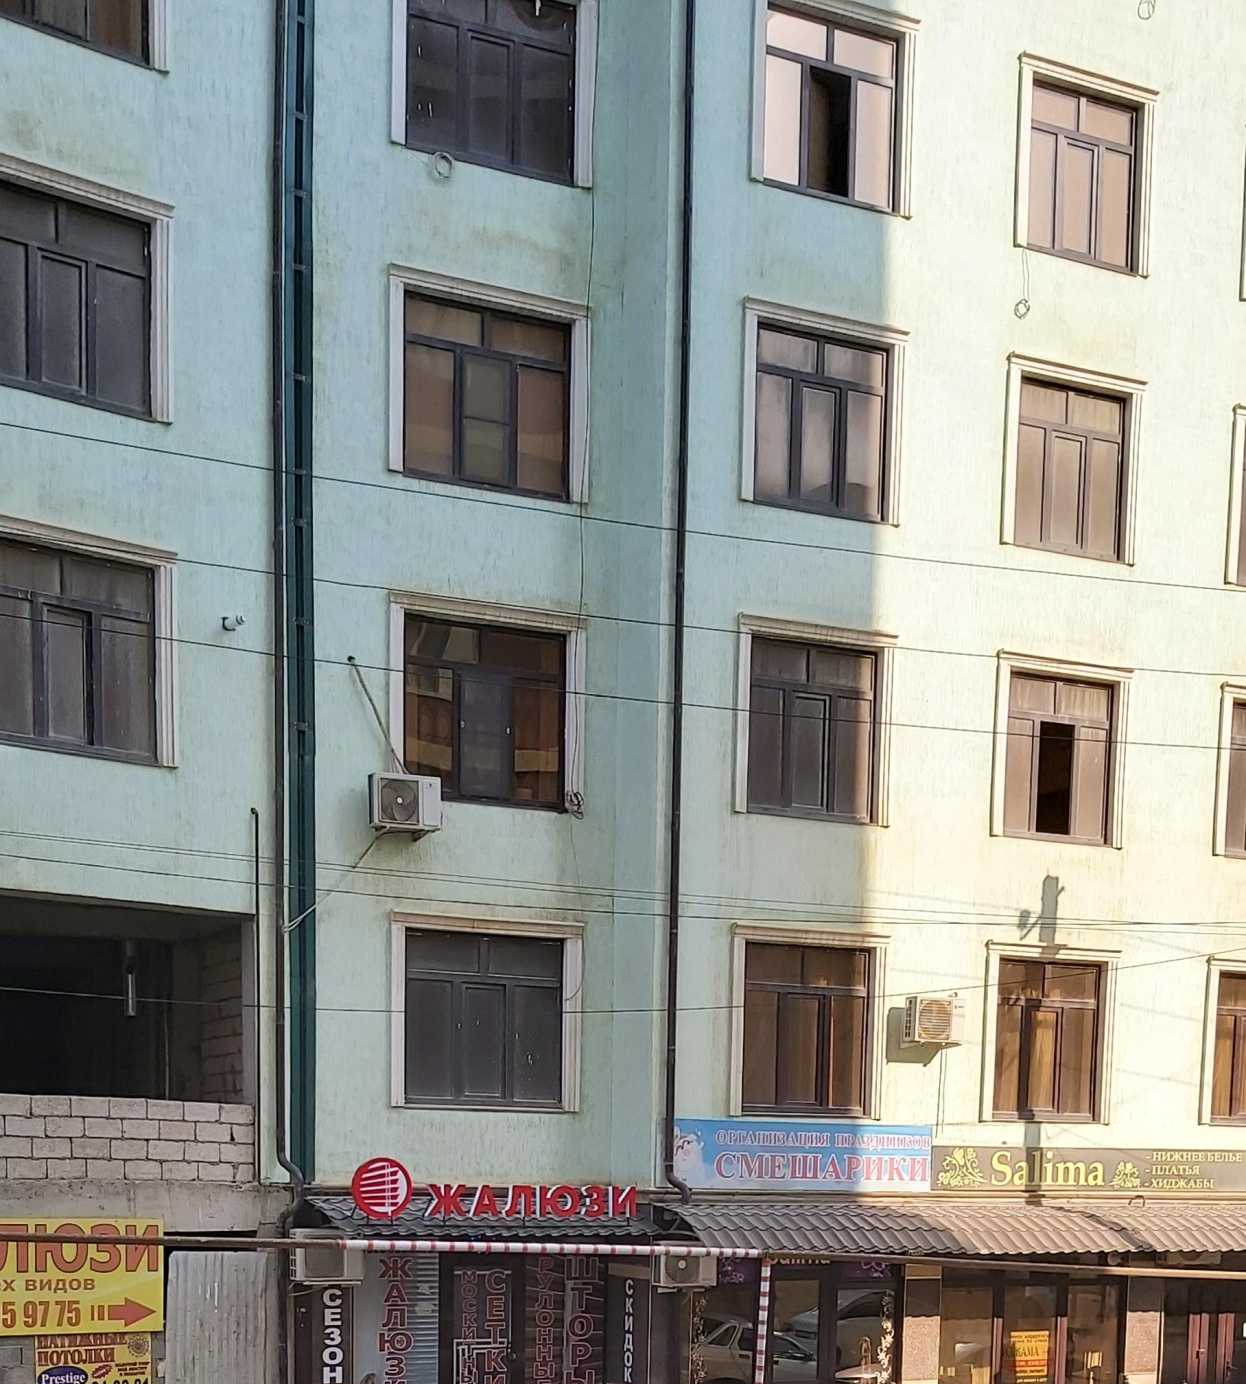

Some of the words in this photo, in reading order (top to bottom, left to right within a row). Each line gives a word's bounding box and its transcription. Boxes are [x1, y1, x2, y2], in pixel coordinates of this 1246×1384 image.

[714, 1129, 830, 1148] ОРГАНИЗАЦИЯ
[834, 1132, 930, 1151] ПРАЗДНИКОВ
[714, 1152, 930, 1182] СМЕШАРИКИ
[990, 1150, 1105, 1186] Salima
[1151, 1164, 1201, 1176] ПЛАТЬЯ
[1151, 1177, 1216, 1190] ХИДЖАБЫ
[424, 1184, 639, 1217] ЖАЛЮЗИ
[25, 1279, 96, 1293] видов
[322, 1288, 344, 1384] СЕЗОН
[623, 1279, 635, 1384] СКИДОК
[37, 1347, 115, 1366] ПОТОЛКИ
